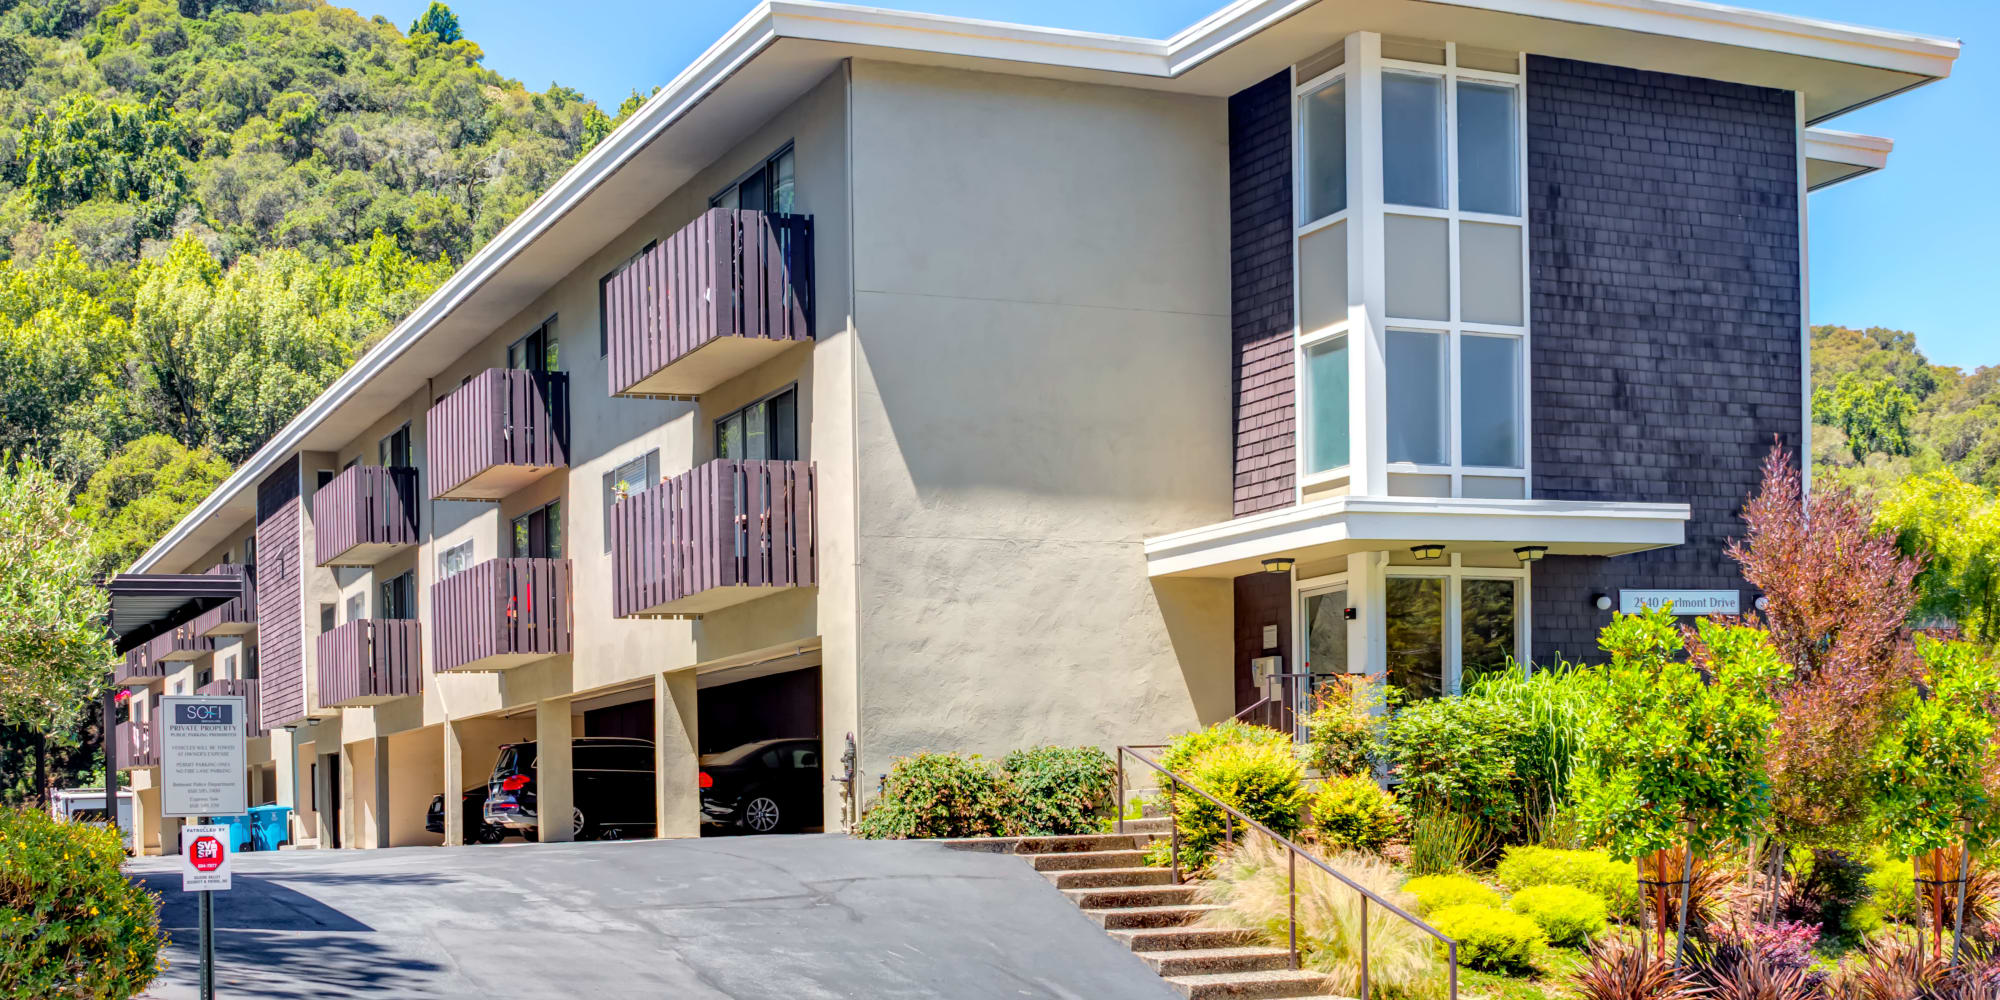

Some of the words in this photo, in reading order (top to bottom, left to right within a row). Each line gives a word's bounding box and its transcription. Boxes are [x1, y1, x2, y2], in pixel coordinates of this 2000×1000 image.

[1662, 597, 1706, 607] Crlmont
[1710, 597, 1736, 607] Drive
[187, 705, 222, 719] SOFI
